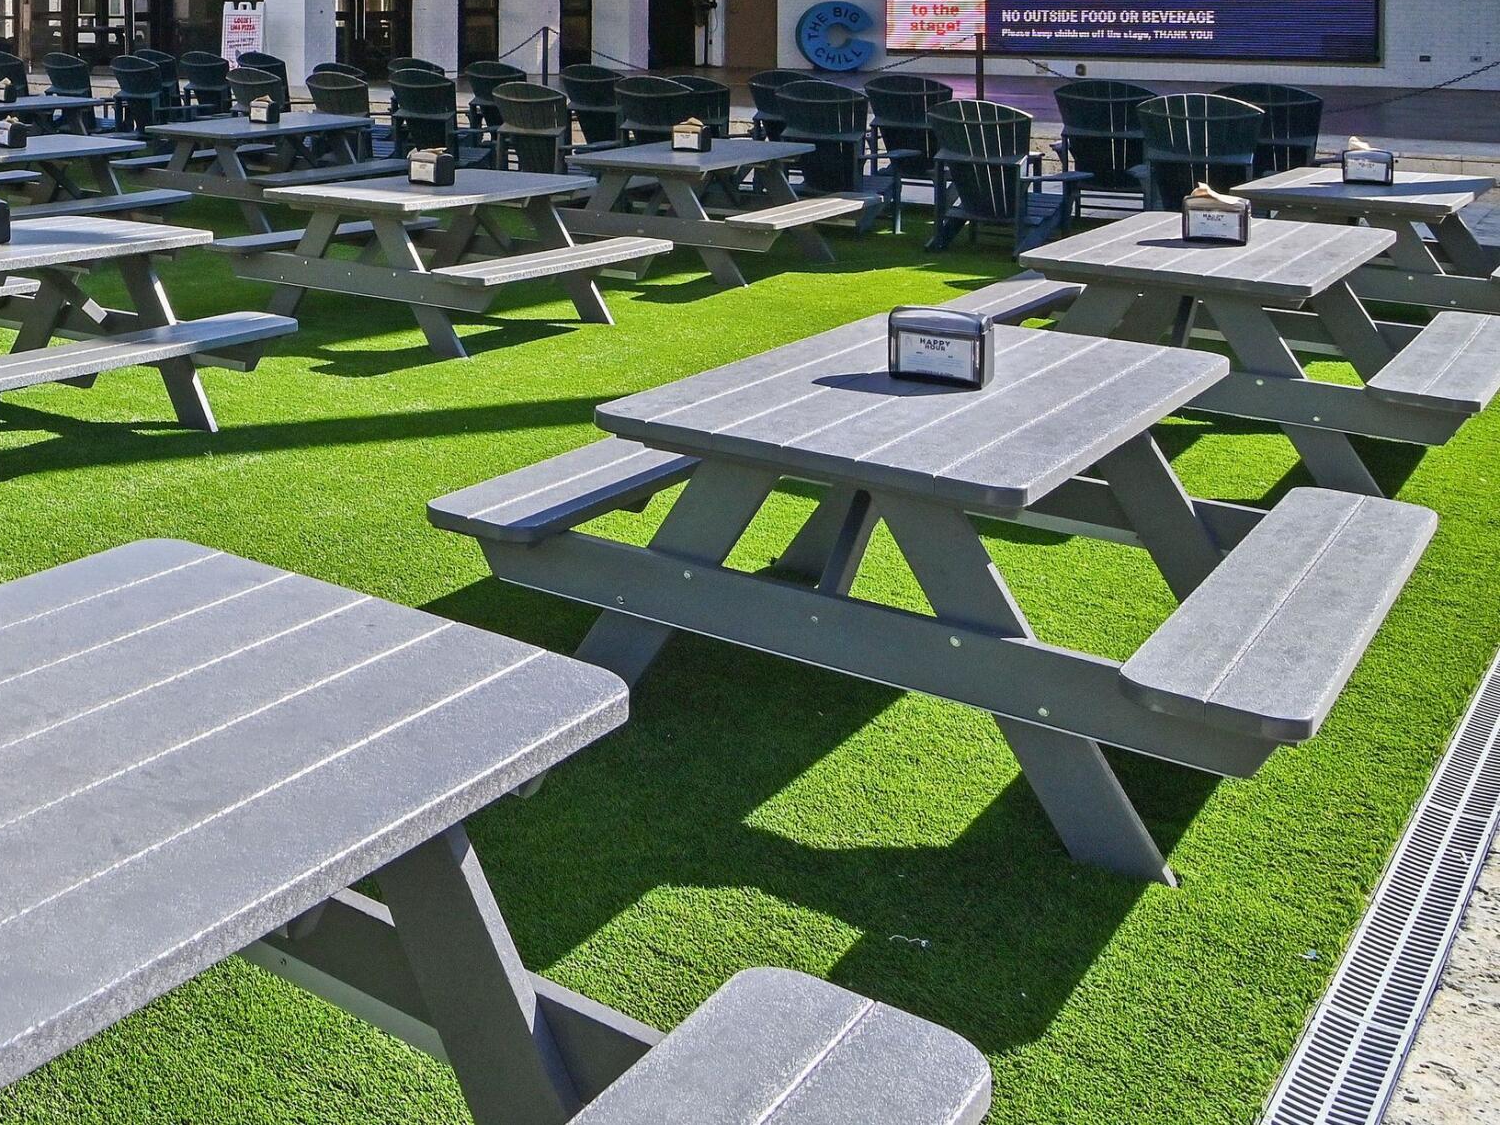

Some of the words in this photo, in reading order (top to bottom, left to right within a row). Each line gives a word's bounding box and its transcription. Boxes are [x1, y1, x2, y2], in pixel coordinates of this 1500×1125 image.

[911, 4, 927, 15] to
[933, 4, 959, 15] the
[808, 12, 828, 41] THE
[833, 7, 860, 23] BIG
[1002, 10, 1020, 22] NO
[1024, 10, 1078, 23] OUTSIDE
[1081, 10, 1116, 23] FOOD
[1120, 10, 1139, 23] OR
[1142, 11, 1215, 24] BEVERAGE
[910, 20, 961, 35] stage!
[1002, 28, 1030, 37] Please
[1032, 29, 1053, 39] keep
[1055, 29, 1090, 37] children
[1092, 29, 1104, 37] off
[1107, 30, 1121, 38] the
[1153, 30, 1188, 39] THANK
[1190, 31, 1213, 39] YOU!
[815, 47, 862, 64] CHILL
[920, 338, 950, 347] HAPPY
